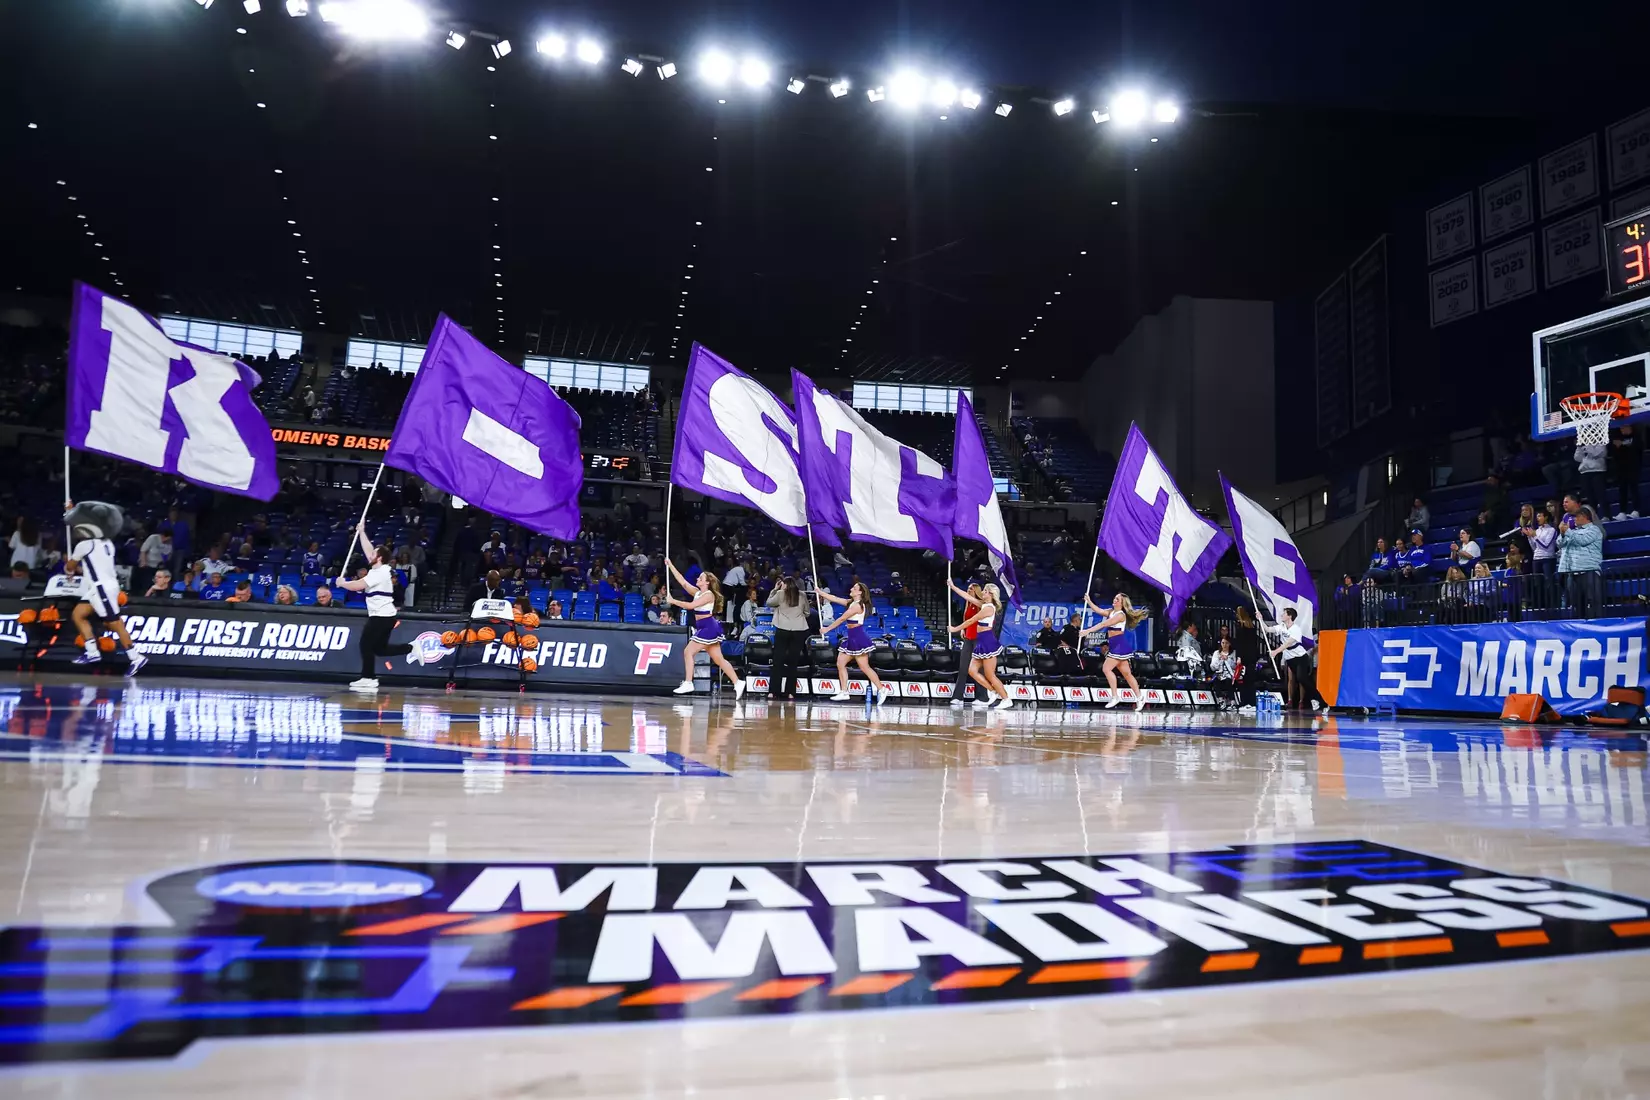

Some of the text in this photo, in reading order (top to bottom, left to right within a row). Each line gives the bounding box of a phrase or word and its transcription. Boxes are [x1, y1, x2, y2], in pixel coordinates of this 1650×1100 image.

[1549, 160, 1587, 186] 1982
[1490, 189, 1522, 212] 1980
[1436, 215, 1464, 235] 1979
[1554, 232, 1591, 256] 2022
[1494, 258, 1524, 279] 2021
[1438, 279, 1468, 299] 2020
[270, 429, 339, 446] OMEN'S
[1014, 605, 1069, 626] FOUR
[180, 618, 259, 645] FIRST
[260, 623, 350, 650] ROUND
[132, 642, 326, 661] OSTED BY THE UNIVERSITY OF KENTUCKY
[634, 641, 672, 675] F
[1455, 637, 1642, 700] MARCH
[448, 857, 1203, 912] MARCH
[589, 877, 1648, 982] MADNESS
